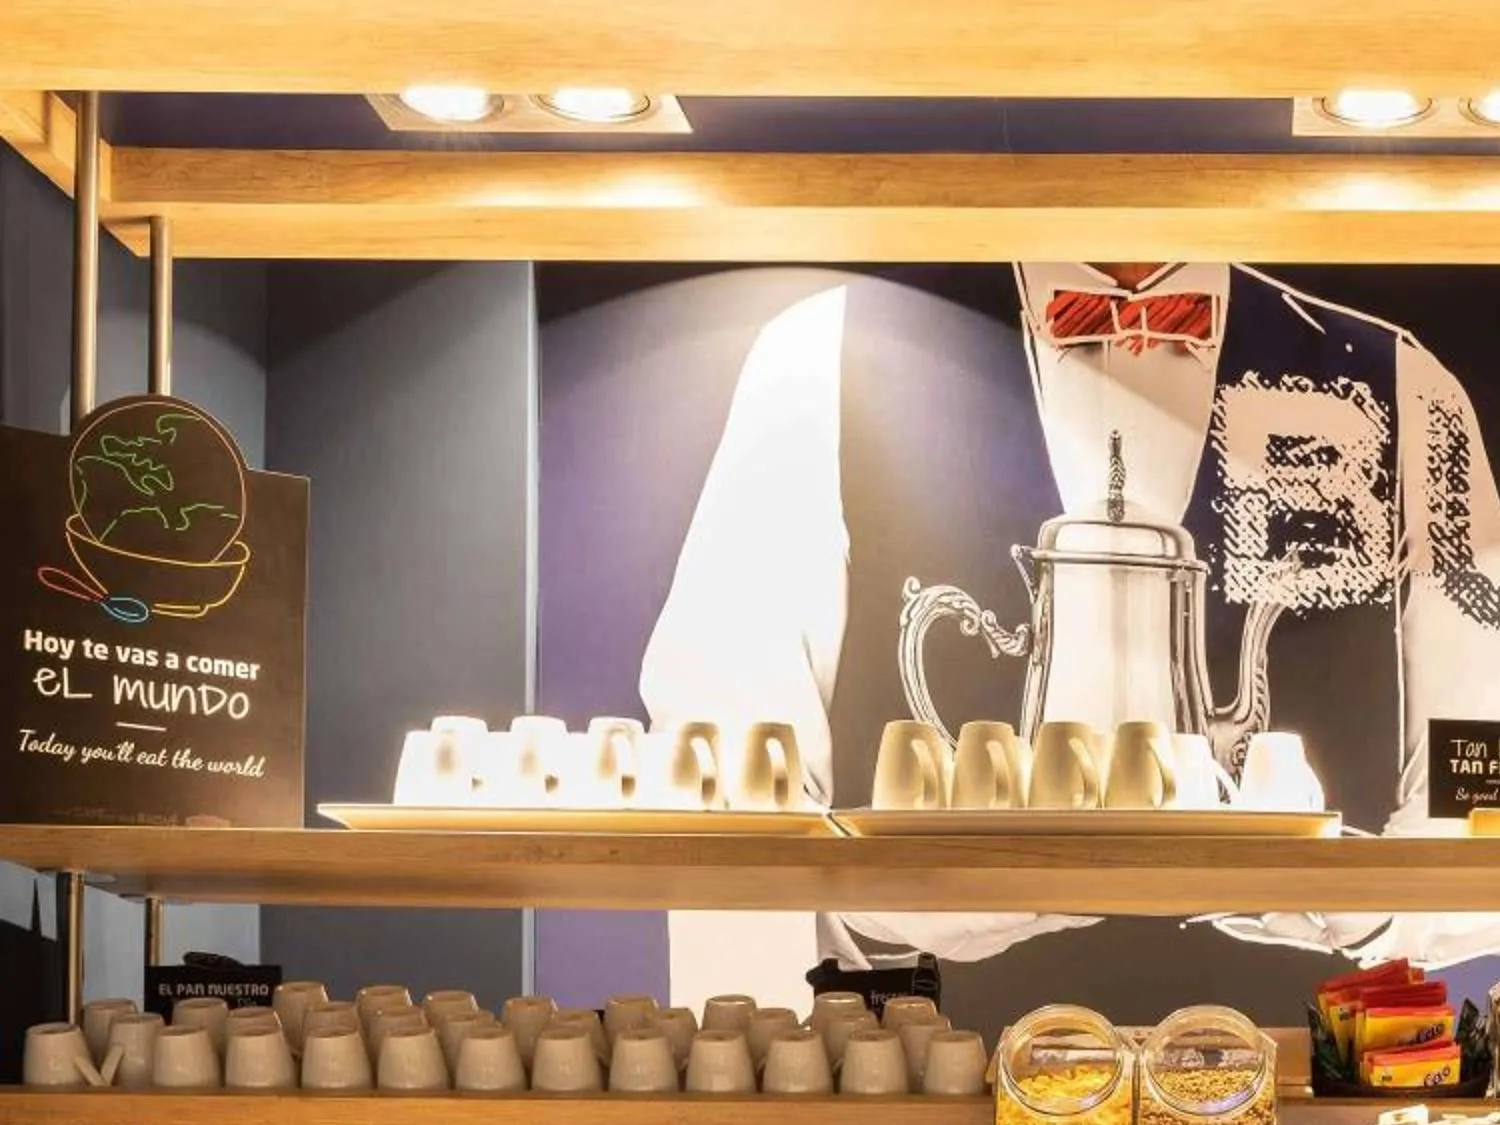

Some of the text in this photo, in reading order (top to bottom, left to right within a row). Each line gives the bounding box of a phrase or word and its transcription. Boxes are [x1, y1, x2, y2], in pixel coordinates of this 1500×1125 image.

[23, 628, 261, 681] Hoy te vas a comer
[19, 728, 267, 778] Today you'll eat the world
[1451, 739, 1487, 758] Tan
[1450, 759, 1483, 775] TAN
[158, 983, 173, 996] EL
